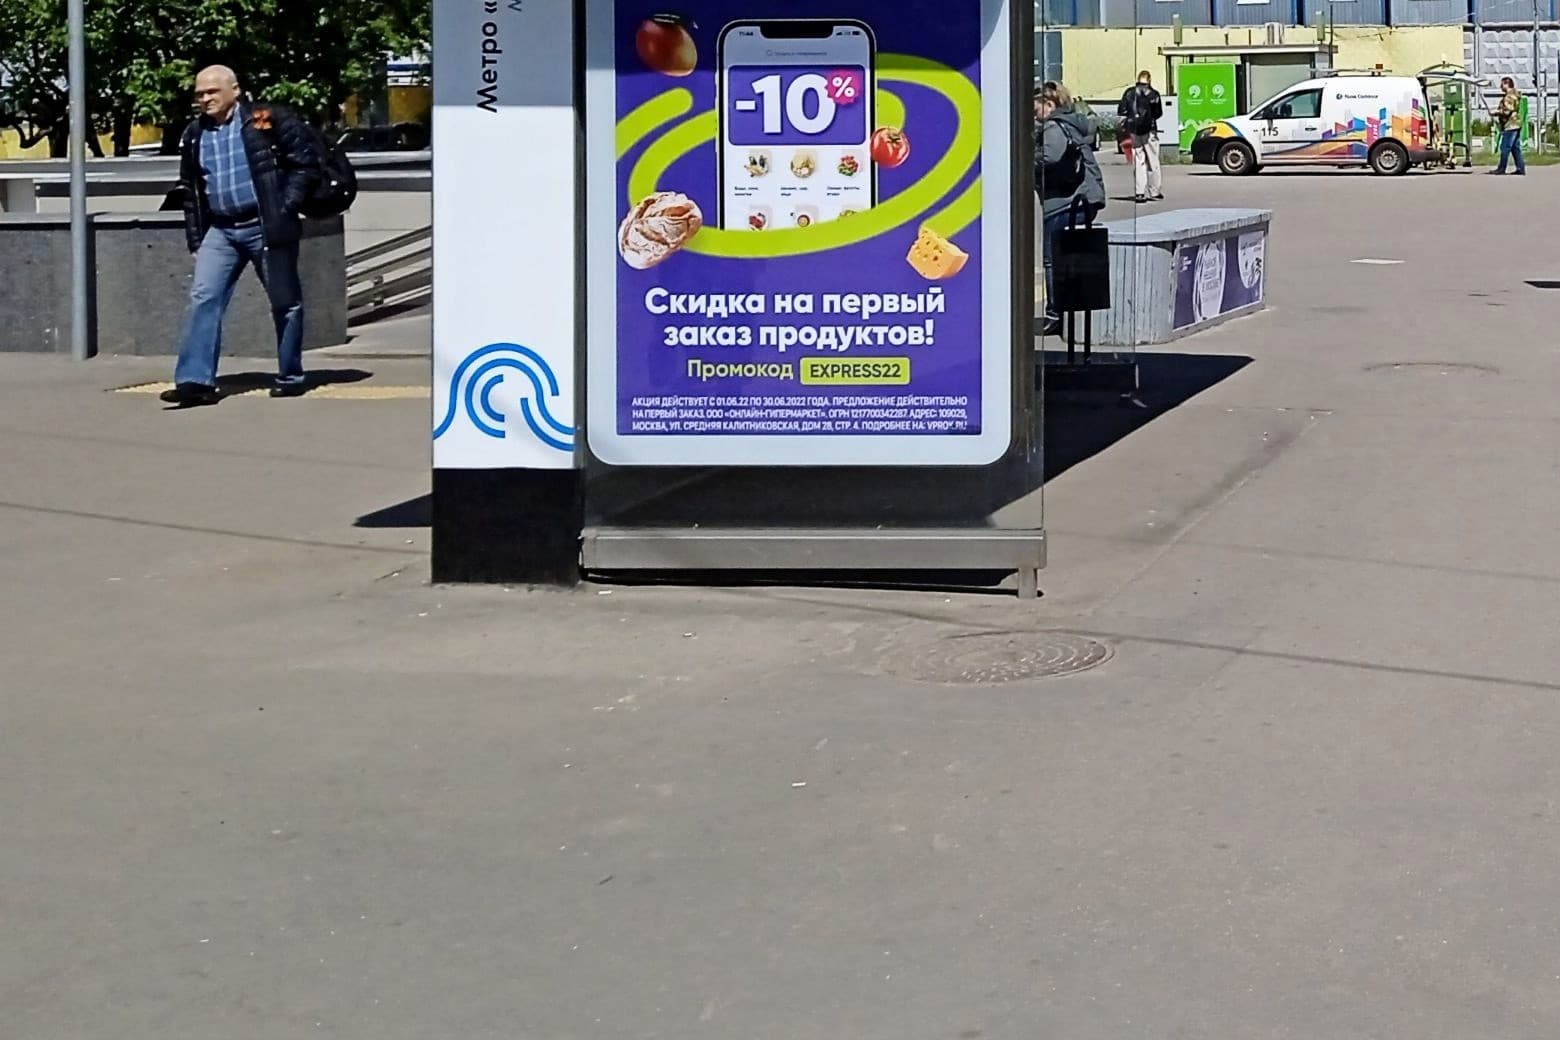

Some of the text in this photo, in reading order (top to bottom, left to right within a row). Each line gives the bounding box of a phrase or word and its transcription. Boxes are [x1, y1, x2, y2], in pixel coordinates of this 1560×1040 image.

[476, 21, 503, 113] Метро
[644, 287, 946, 320] Скидка на первый
[664, 320, 935, 352] заказ продуктов!
[688, 359, 901, 381] Промокод EXPRESS22
[632, 397, 660, 407] АКЦИЯ
[661, 395, 708, 407] ДЕЙСТВУЕТ
[750, 397, 761, 406] ПО
[832, 396, 895, 407] ПРЕДЛОЖЕНИЕ
